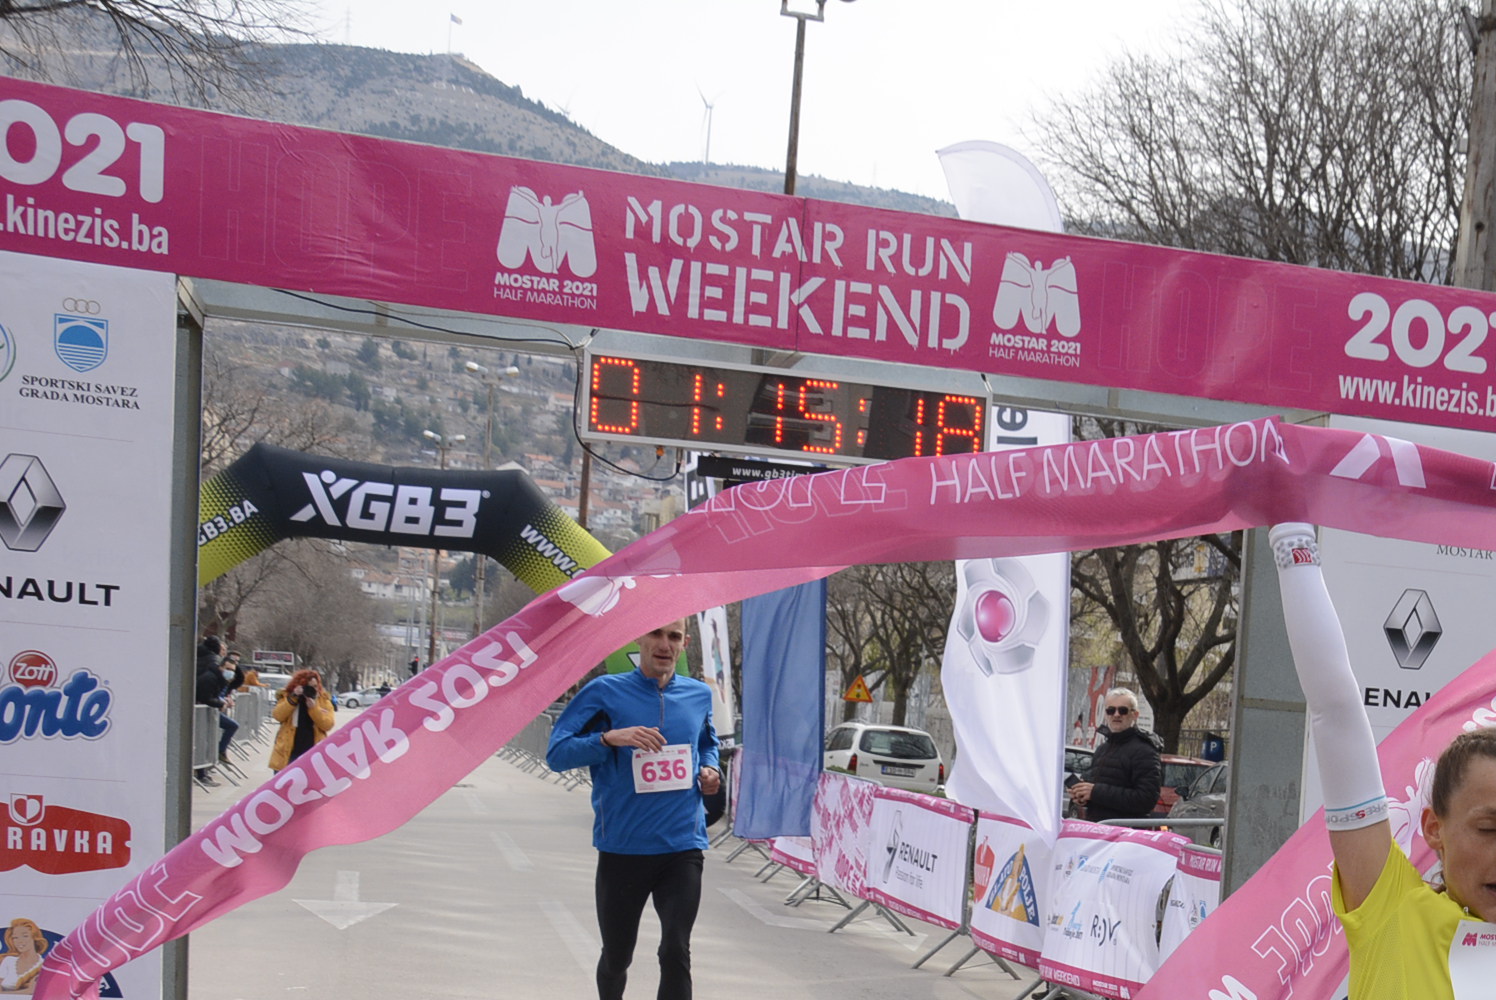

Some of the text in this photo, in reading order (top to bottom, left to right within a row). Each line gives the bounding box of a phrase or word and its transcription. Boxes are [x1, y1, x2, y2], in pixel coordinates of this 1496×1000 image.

[625, 196, 973, 283] MOSTAR RUN
[495, 272, 598, 297] MOSTAR 2021
[494, 287, 598, 310] HALF MARATHON
[624, 252, 971, 353] WEEKEND
[990, 333, 1081, 355] MOSTAR 2021
[989, 347, 1081, 367] HALF MARATHON
[22, 375, 138, 399] SPORTSKI SAVEZ
[19, 388, 140, 411] GRADA MOSTARA
[930, 452, 1027, 505] HALF
[1043, 419, 1290, 494] MARATHON
[1437, 544, 1494, 561] MOSTAR
[15, 662, 55, 681] Zott
[1364, 687, 1431, 710] ENA
[641, 759, 687, 783] 636
[899, 842, 938, 873] RENAULT
[1019, 866, 1036, 922] POLJE
